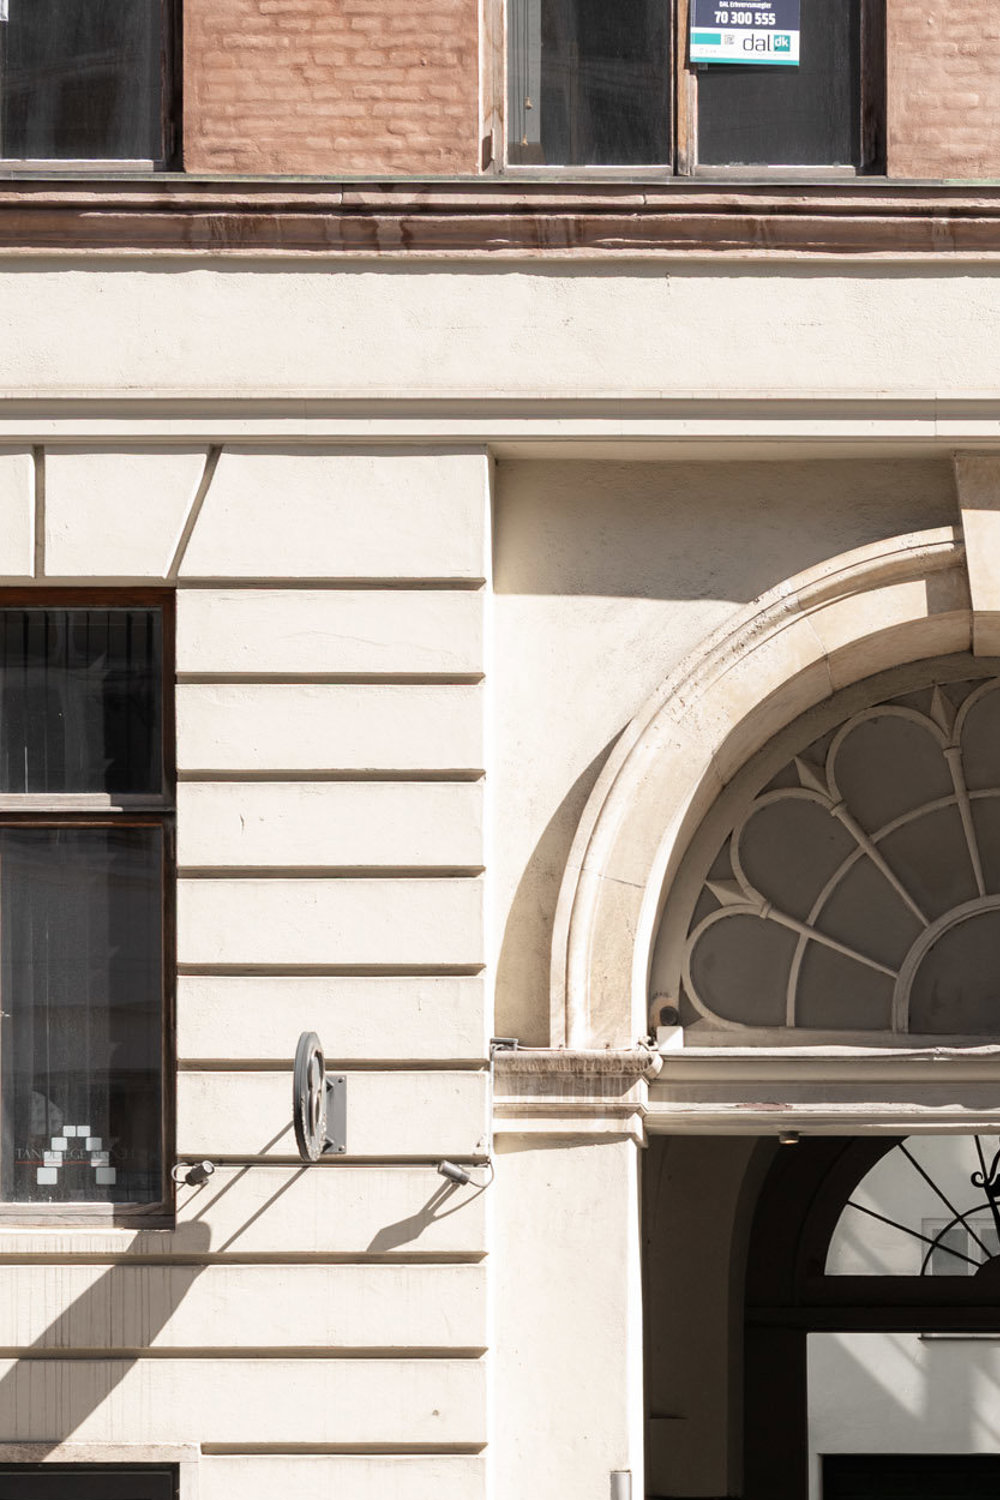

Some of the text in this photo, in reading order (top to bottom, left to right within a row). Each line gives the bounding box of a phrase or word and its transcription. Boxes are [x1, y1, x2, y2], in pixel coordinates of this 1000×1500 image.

[714, 11, 776, 25] 70 300 555
[743, 33, 771, 52] dal
[775, 36, 788, 47] dk
